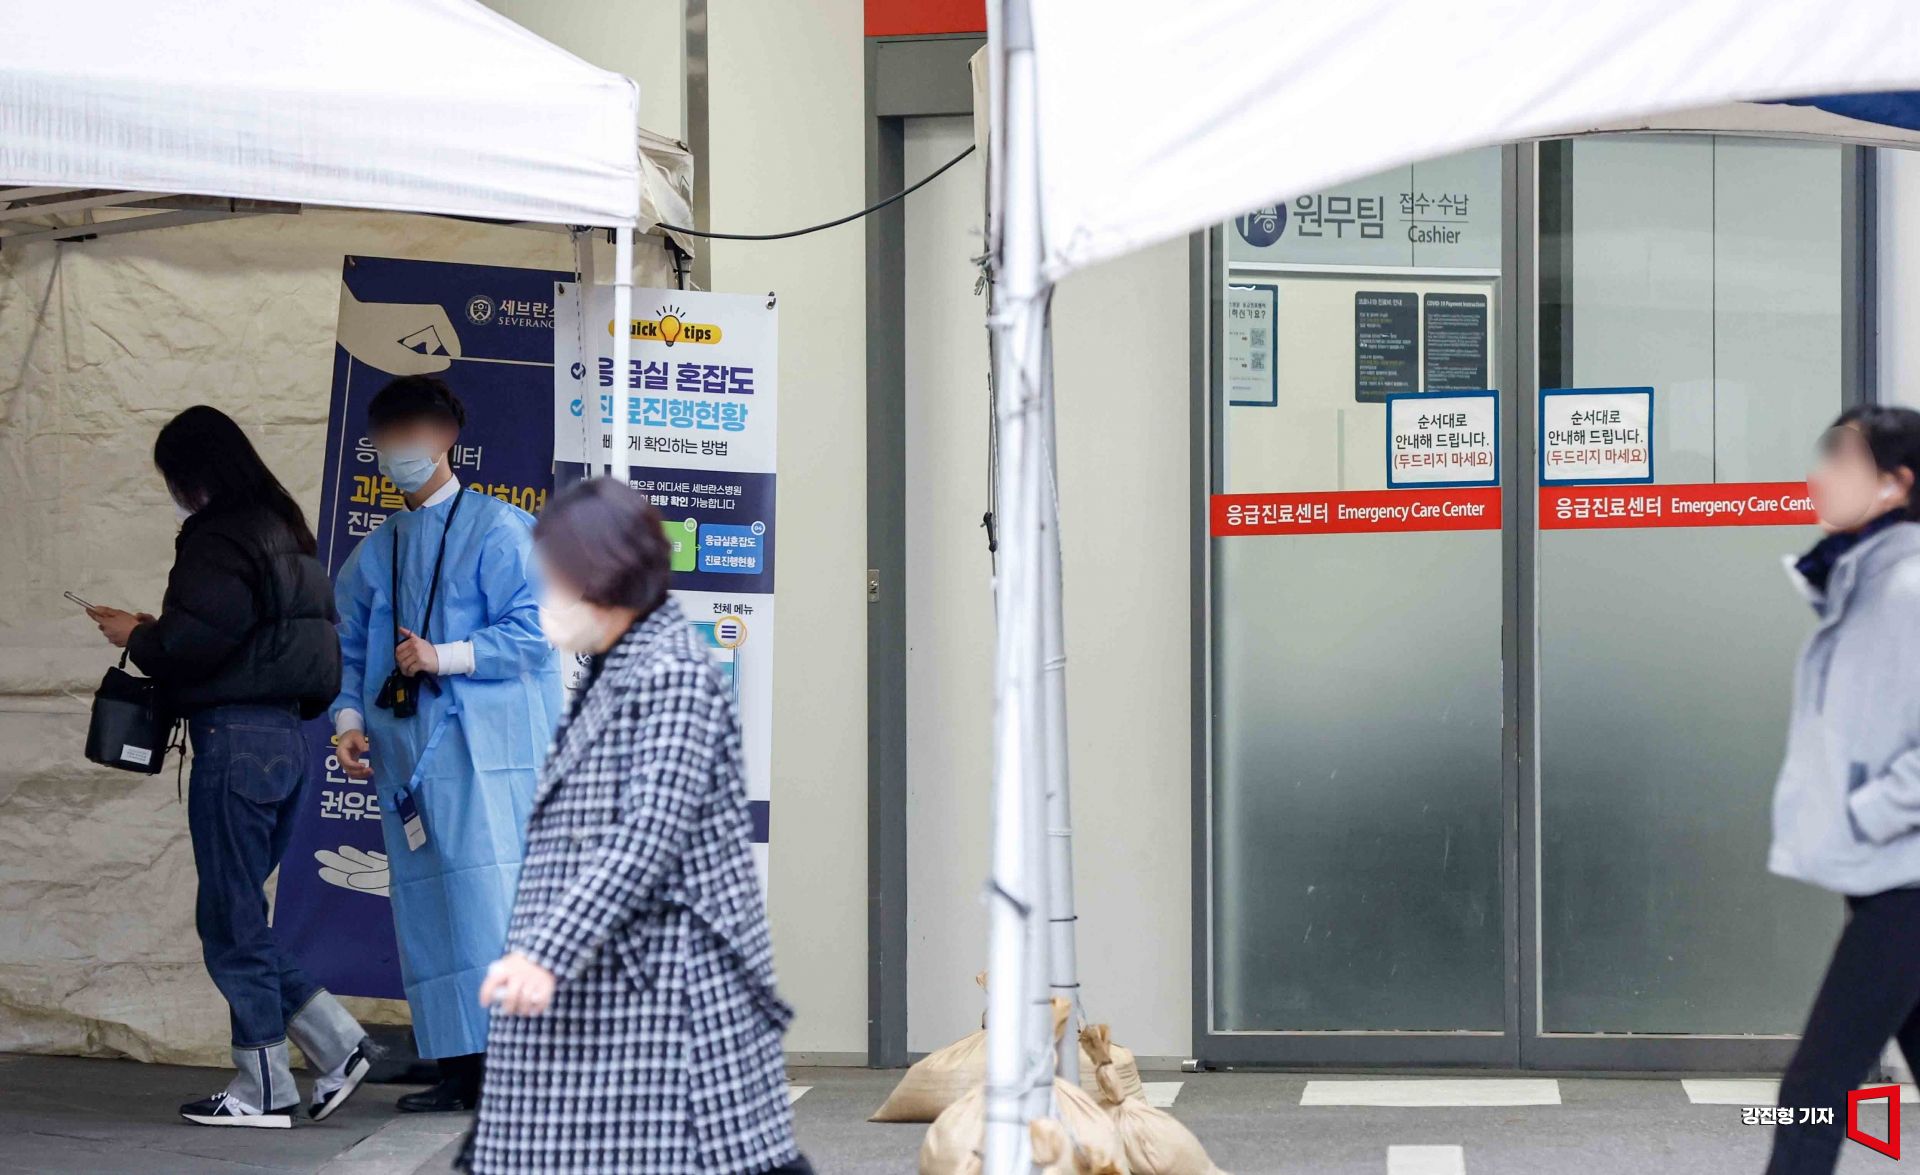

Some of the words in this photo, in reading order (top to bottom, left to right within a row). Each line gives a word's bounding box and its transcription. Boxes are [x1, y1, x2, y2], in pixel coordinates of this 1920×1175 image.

[1400, 193, 1469, 216] 접수·수납
[1294, 194, 1384, 239] 원무팀
[1408, 225, 1461, 244] Cashier
[630, 321, 657, 337] uick
[684, 325, 711, 342] tips
[676, 362, 754, 395] 혼잡도
[1417, 413, 1467, 430] 순서대로
[1570, 410, 1621, 426] 순서대로
[602, 434, 641, 452] 빠게
[644, 436, 698, 455] 확인하는
[701, 440, 728, 456] 방법
[1395, 432, 1432, 450] 안내해
[1435, 431, 1490, 448] 드립니다.
[1548, 429, 1585, 446] 안내해
[1589, 428, 1644, 445] 드립니다.
[1394, 452, 1447, 469] (두드리지
[1451, 450, 1493, 468] 마세요)
[1546, 449, 1601, 466] (두드리지
[1604, 448, 1648, 464] 마세요)
[657, 481, 690, 493] 어디서든
[692, 484, 742, 496] 세브란스병원
[650, 494, 669, 506] 현황
[671, 495, 689, 507] 확인
[691, 497, 735, 509] 가능합니다
[1556, 495, 1661, 519] 응급진료센터
[1671, 497, 1745, 517] Emergency
[1747, 496, 1778, 512] Care
[1226, 502, 1328, 526] 응급진료센터
[1338, 503, 1409, 523] Emergency
[1411, 502, 1441, 518] Care
[1442, 501, 1485, 518] Center
[705, 534, 757, 547] 응급실혼잡도
[705, 555, 756, 568] 진료진행현황
[712, 602, 731, 615] 전체
[733, 603, 753, 615] 메뉴
